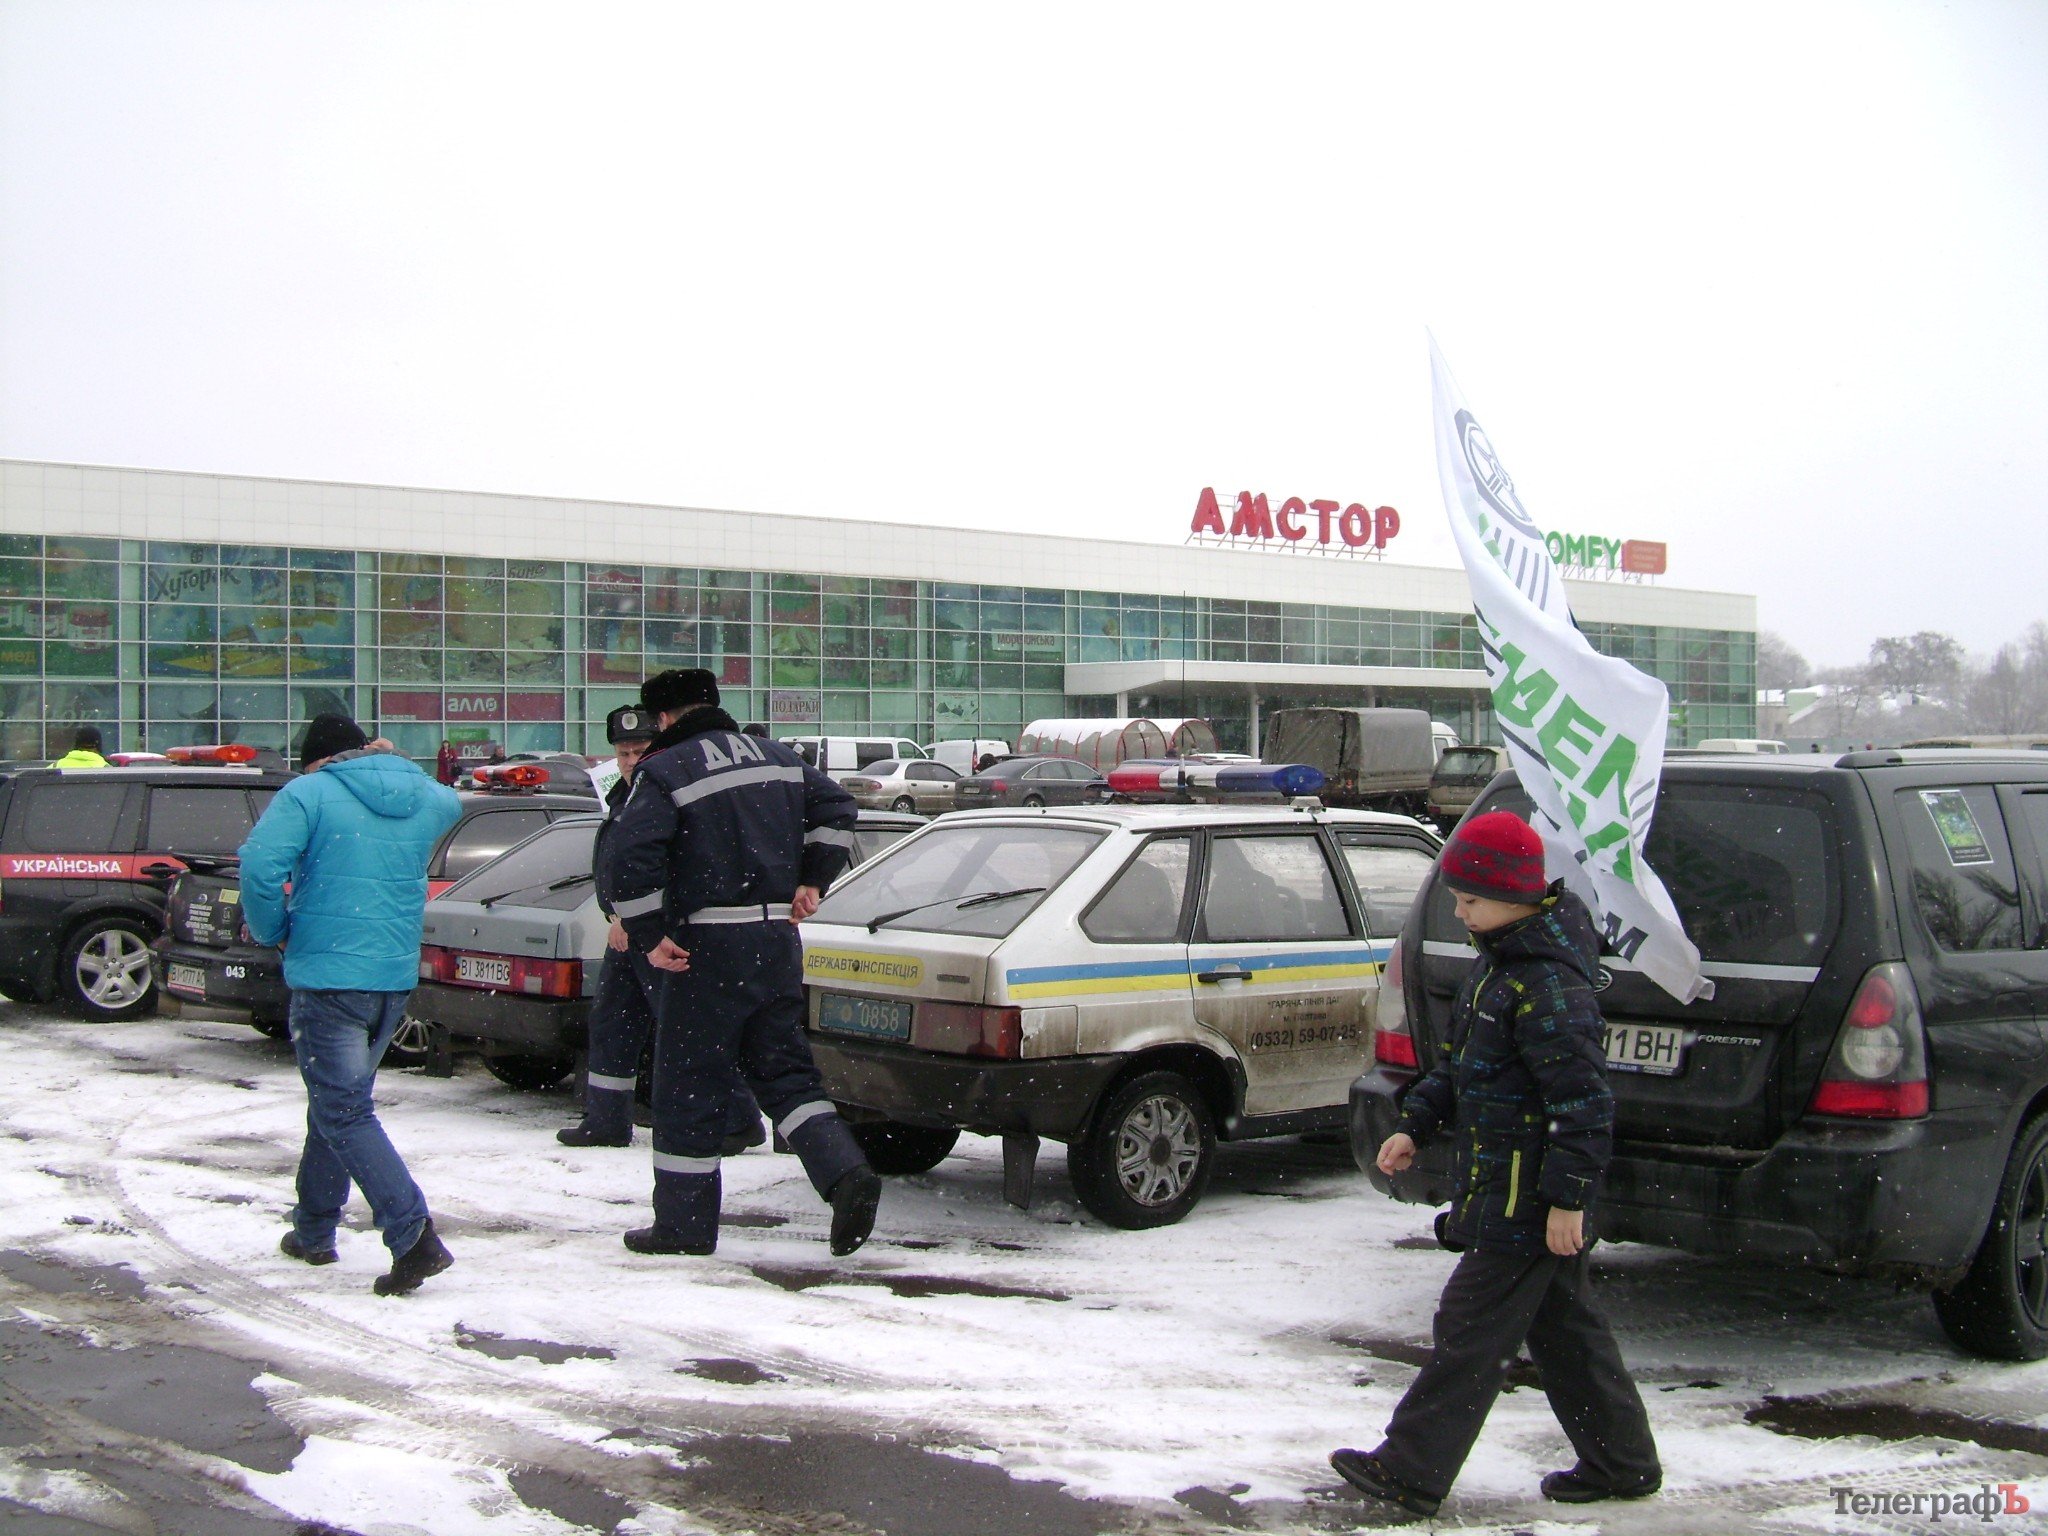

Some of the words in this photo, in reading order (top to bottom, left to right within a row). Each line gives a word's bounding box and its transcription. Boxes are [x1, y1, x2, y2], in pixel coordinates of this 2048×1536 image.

[1191, 487, 1400, 549] АМСТОР
[1546, 531, 1621, 569] OMFY
[772, 700, 820, 714] ПОДАРКИ
[699, 734, 766, 770] ДАІ
[12, 857, 122, 873] УКРАЇНСЬКА
[226, 965, 246, 978] 043
[475, 961, 495, 979] 3811
[860, 1003, 899, 1031] 0858
[1251, 1030, 1294, 1051] (0532)
[1299, 1025, 1357, 1043] 59-07-25
[1634, 1030, 1676, 1062] BH
[1698, 1034, 1762, 1046] FORESTER
